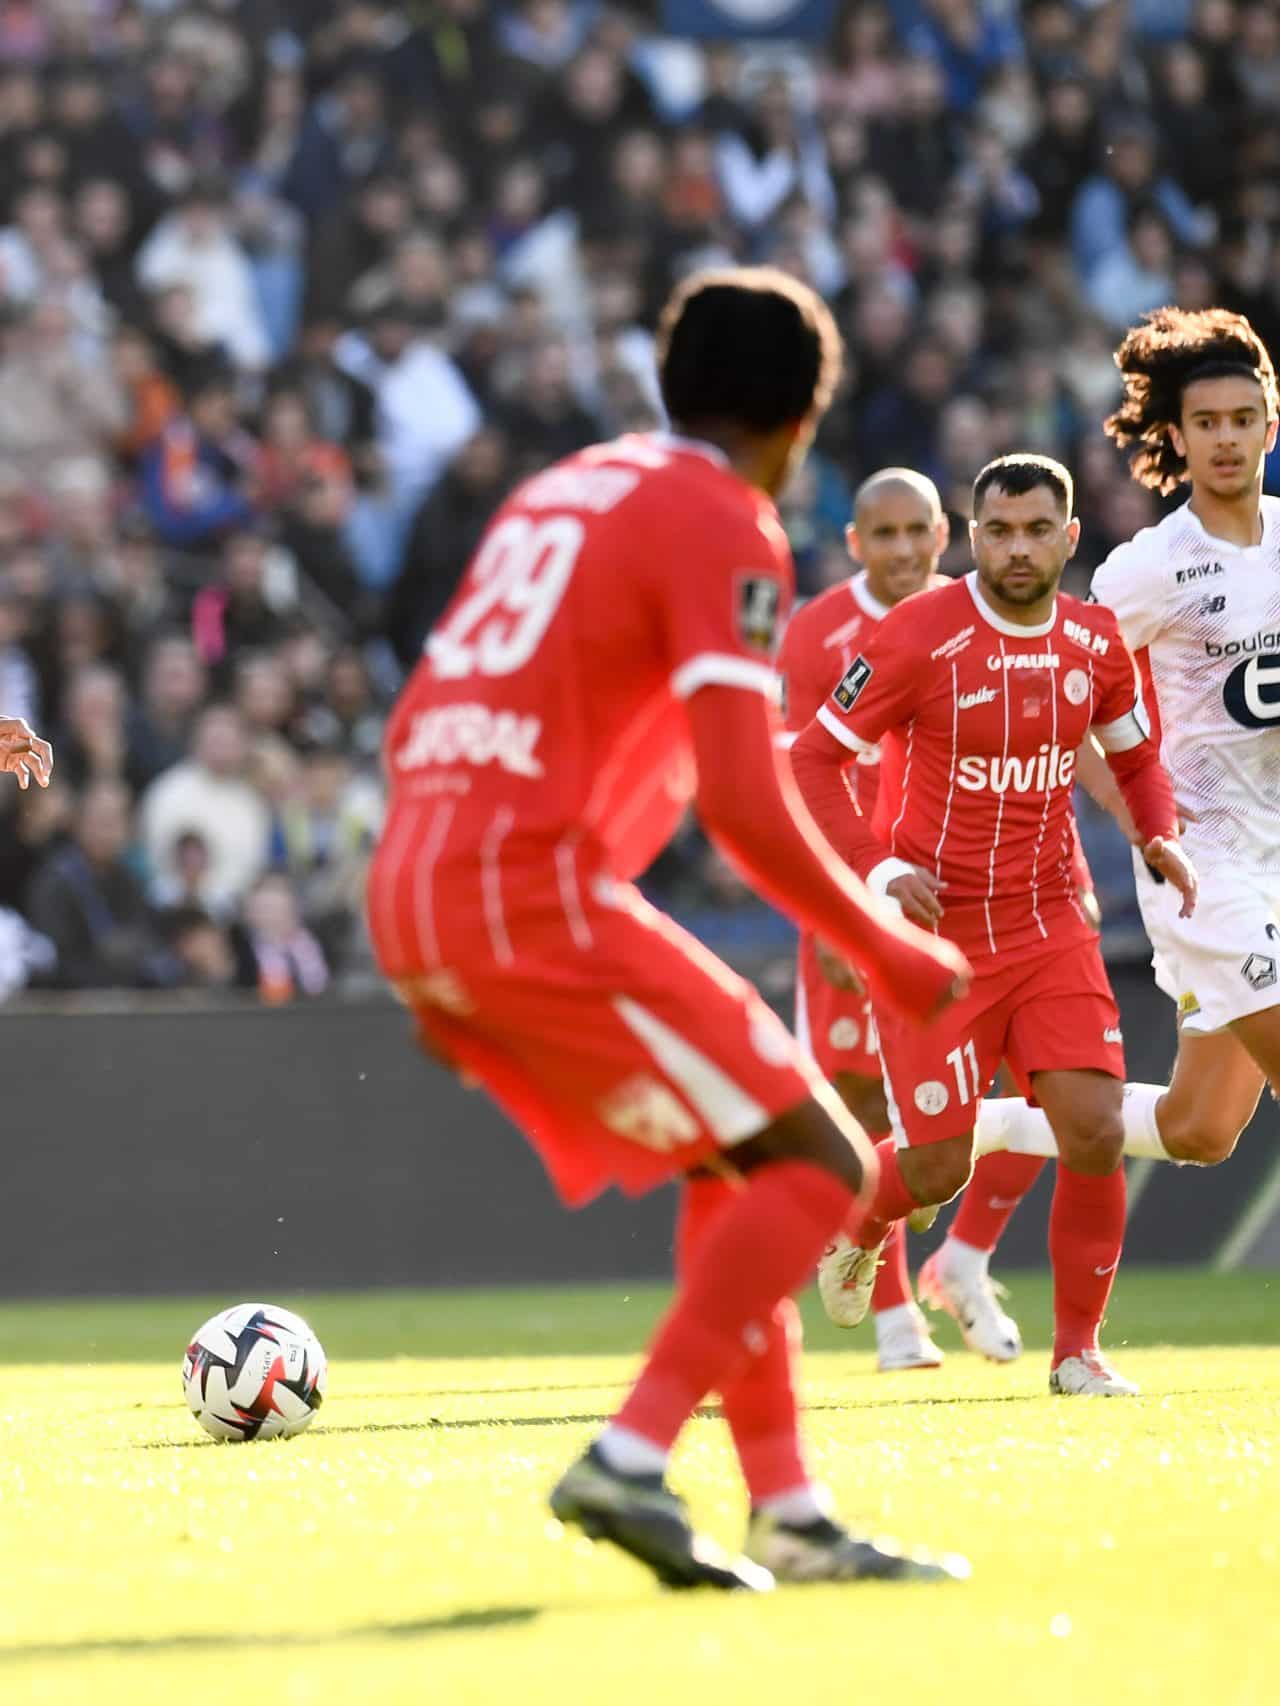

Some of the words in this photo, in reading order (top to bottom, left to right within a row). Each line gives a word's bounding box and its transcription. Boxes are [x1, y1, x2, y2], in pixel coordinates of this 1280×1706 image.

[425, 514, 585, 680] 29
[1205, 631, 1280, 657] boula
[956, 743, 1075, 793] swile
[946, 1036, 979, 1106] 11
